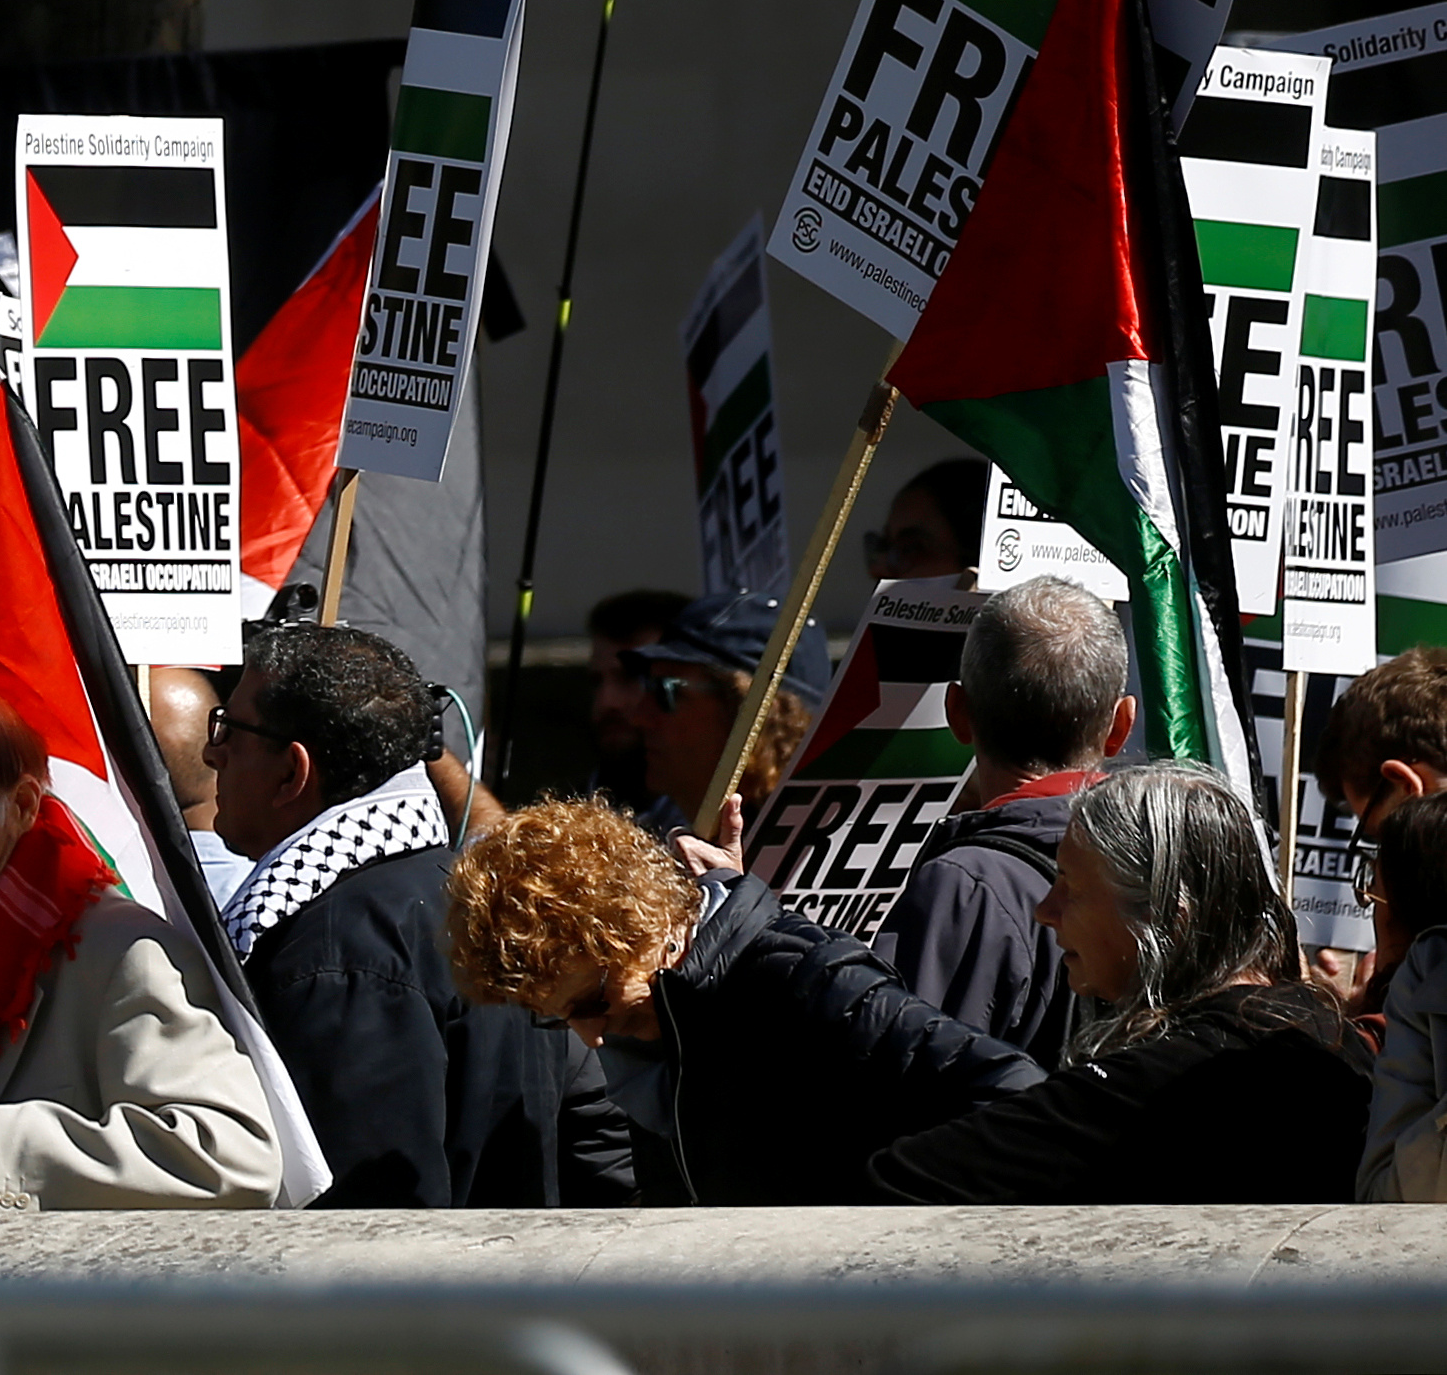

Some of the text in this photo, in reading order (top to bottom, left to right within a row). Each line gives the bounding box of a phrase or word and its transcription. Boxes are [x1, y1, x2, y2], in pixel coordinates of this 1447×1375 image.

[1324, 27, 1427, 66] Solidarity
[1220, 65, 1315, 100] Campaign
[25, 133, 214, 163] Palestine Solidarity Campaign
[818, 95, 982, 241] PALES
[807, 166, 852, 212] END
[852, 196, 934, 266] ISRAELI
[359, 293, 463, 367] STINE
[357, 368, 451, 408] OCCUPATION
[34, 357, 231, 485] FREE
[68, 491, 231, 551] ALESTINE
[89, 563, 231, 592] SRAELI OCCUPATION
[875, 596, 944, 623] Palestine
[742, 782, 959, 890] FREE
